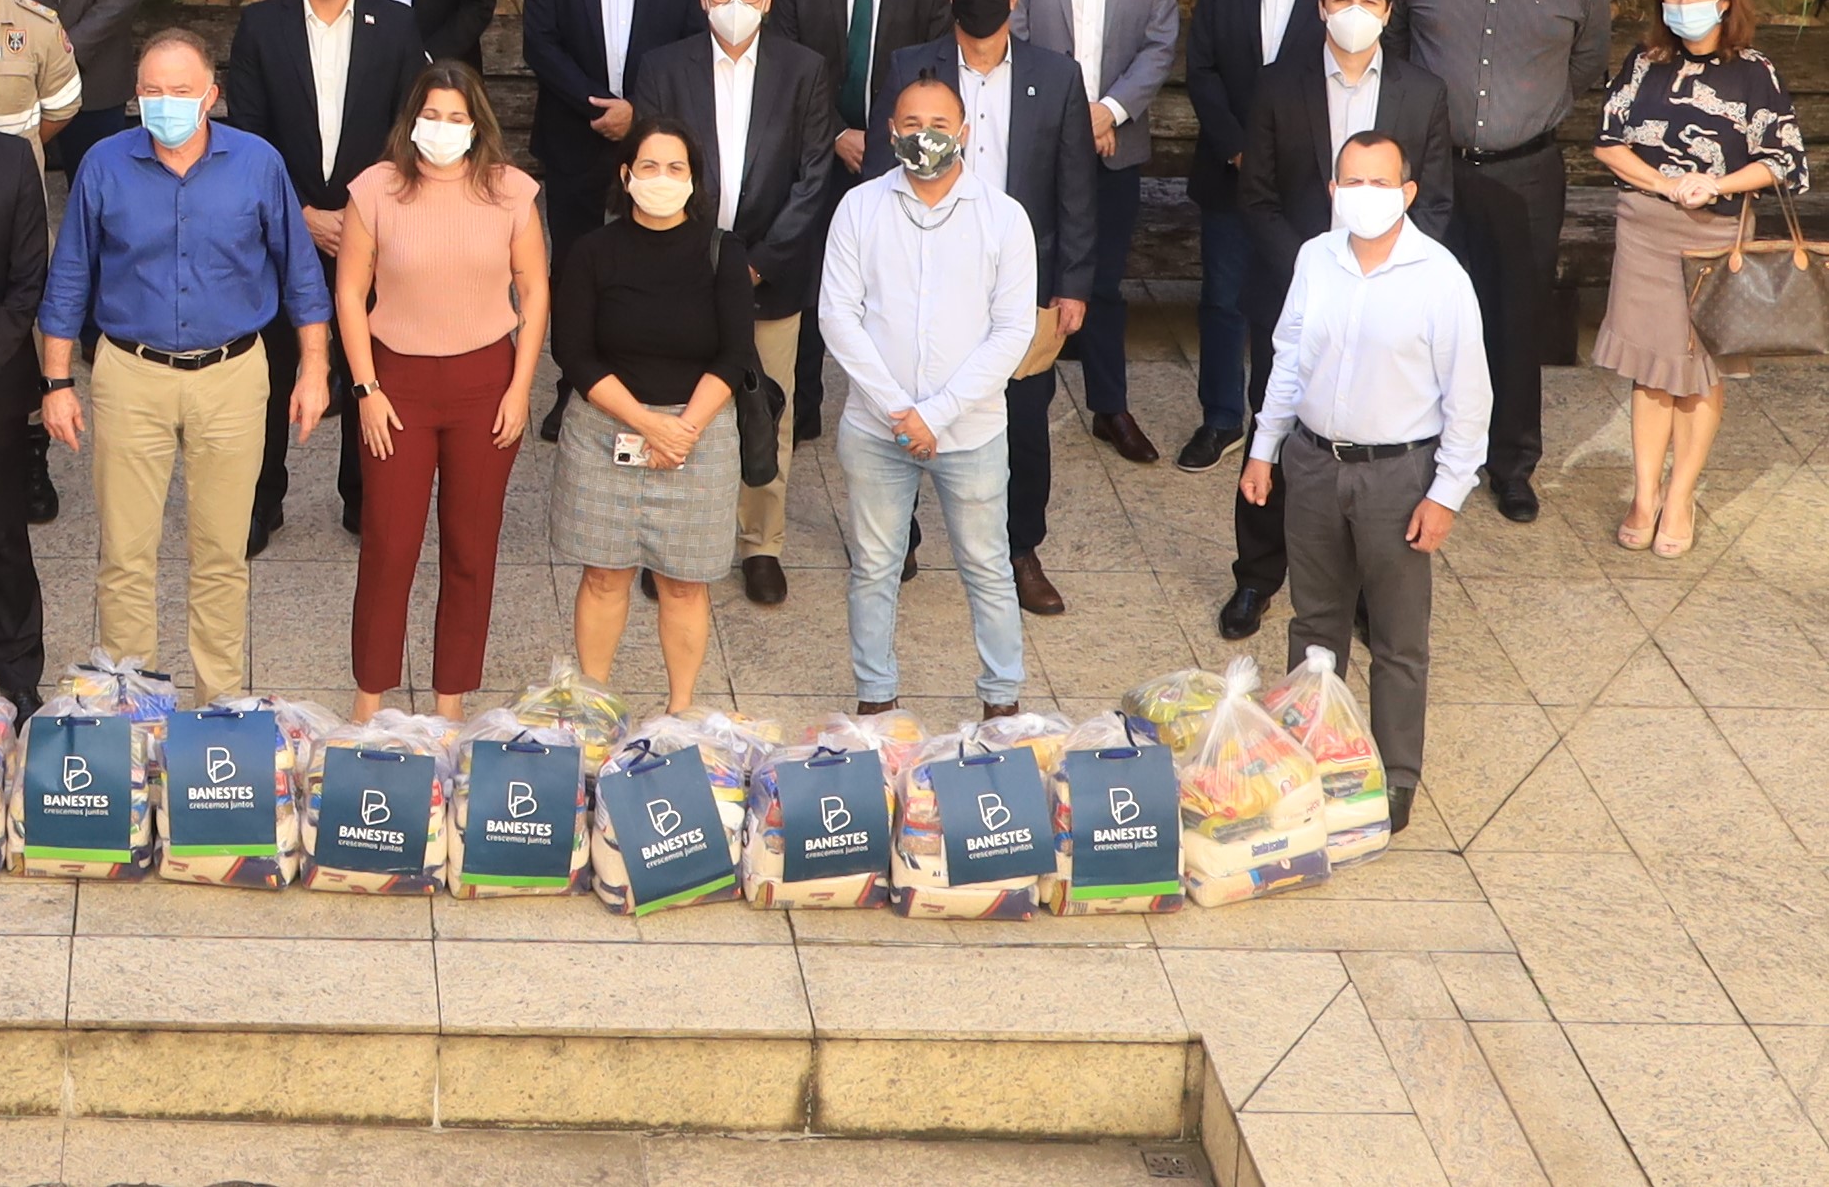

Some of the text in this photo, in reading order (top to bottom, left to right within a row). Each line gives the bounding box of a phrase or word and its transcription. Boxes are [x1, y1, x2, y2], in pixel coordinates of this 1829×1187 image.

[43, 794, 109, 808] BANESTES
[188, 786, 254, 800] BANESTES
[338, 825, 404, 844] BANESTES
[486, 819, 552, 836] BANESTES
[1093, 825, 1158, 842] BANESTES
[641, 828, 704, 860] BANESTES
[805, 831, 868, 851] BANESTES
[966, 828, 1032, 851] BANESTES
